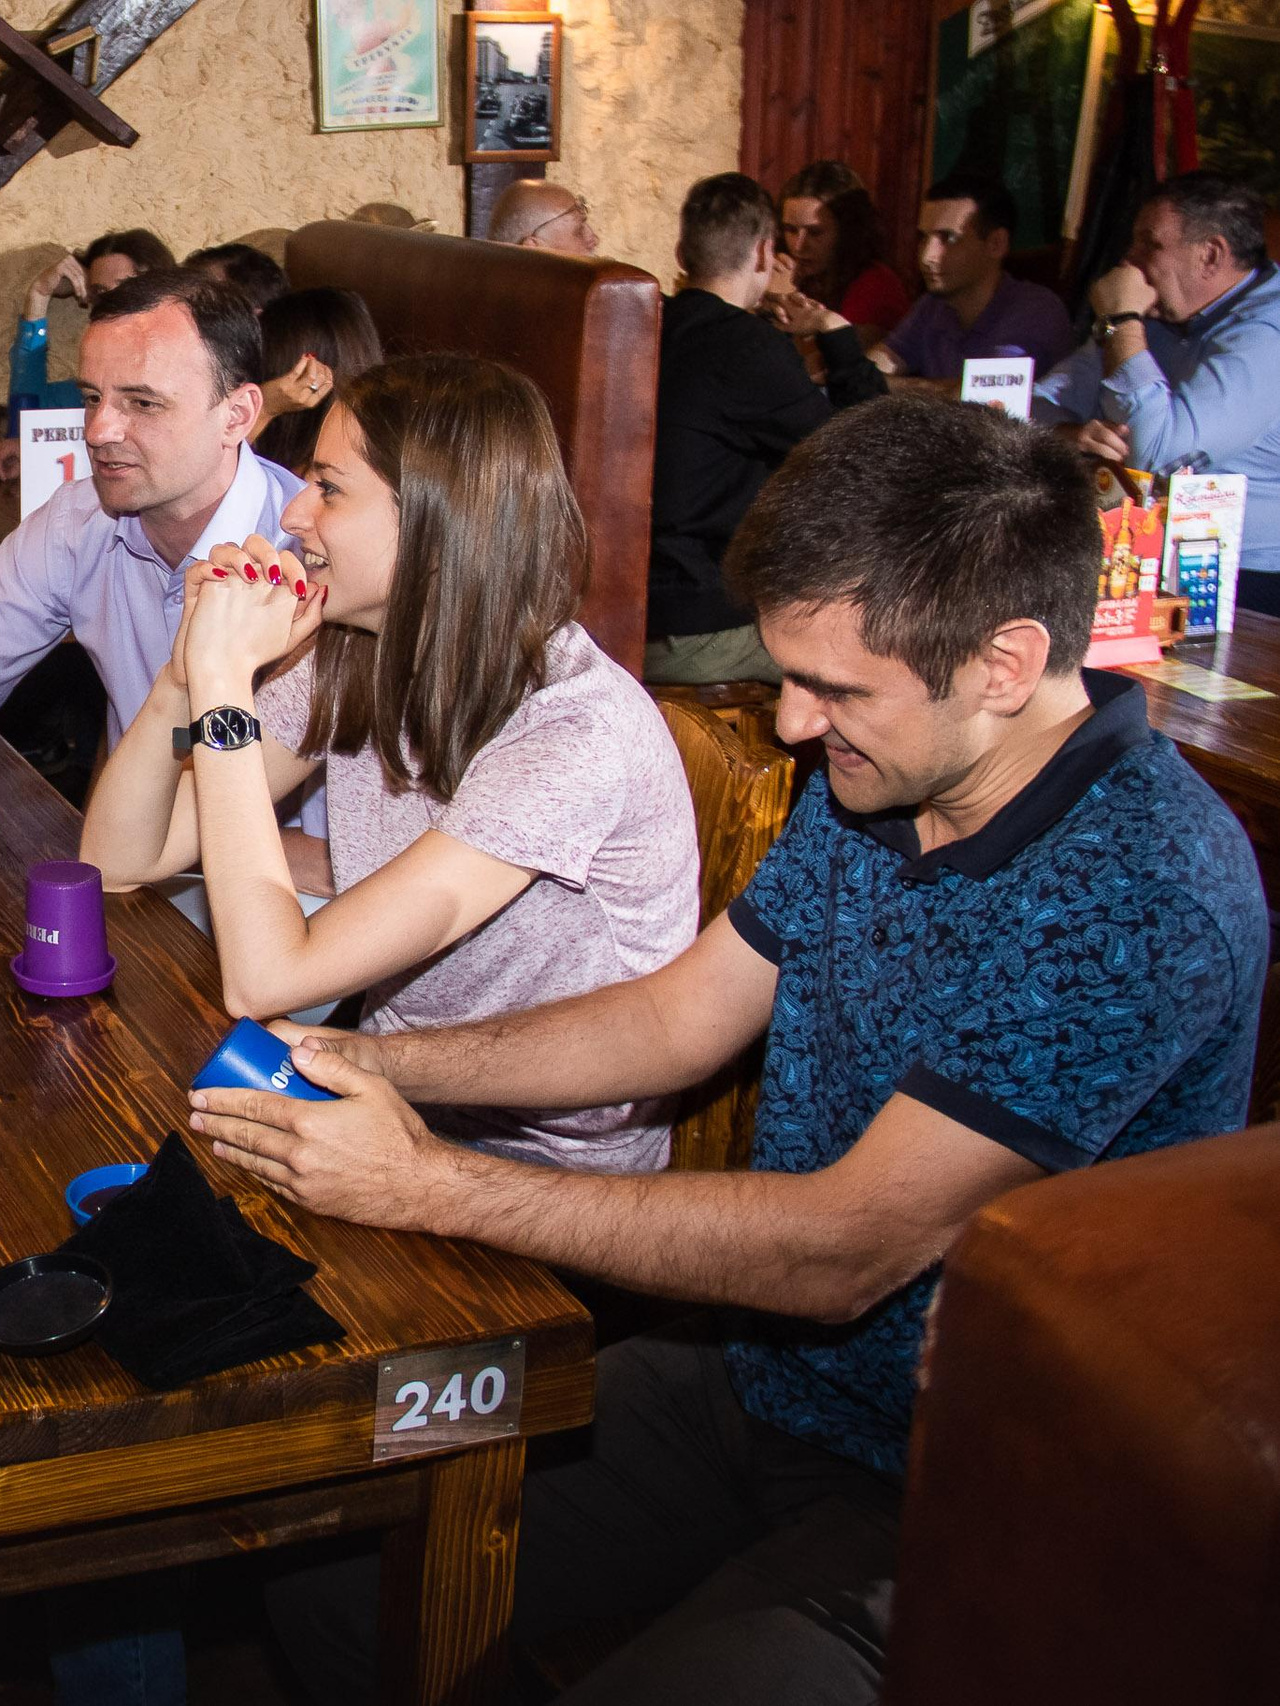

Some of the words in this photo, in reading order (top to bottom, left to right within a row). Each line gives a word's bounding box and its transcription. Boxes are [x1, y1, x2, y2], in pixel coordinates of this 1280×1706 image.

[971, 373, 1024, 387] PERUDO
[56, 452, 75, 483] 1
[391, 1366, 506, 1432] 240
